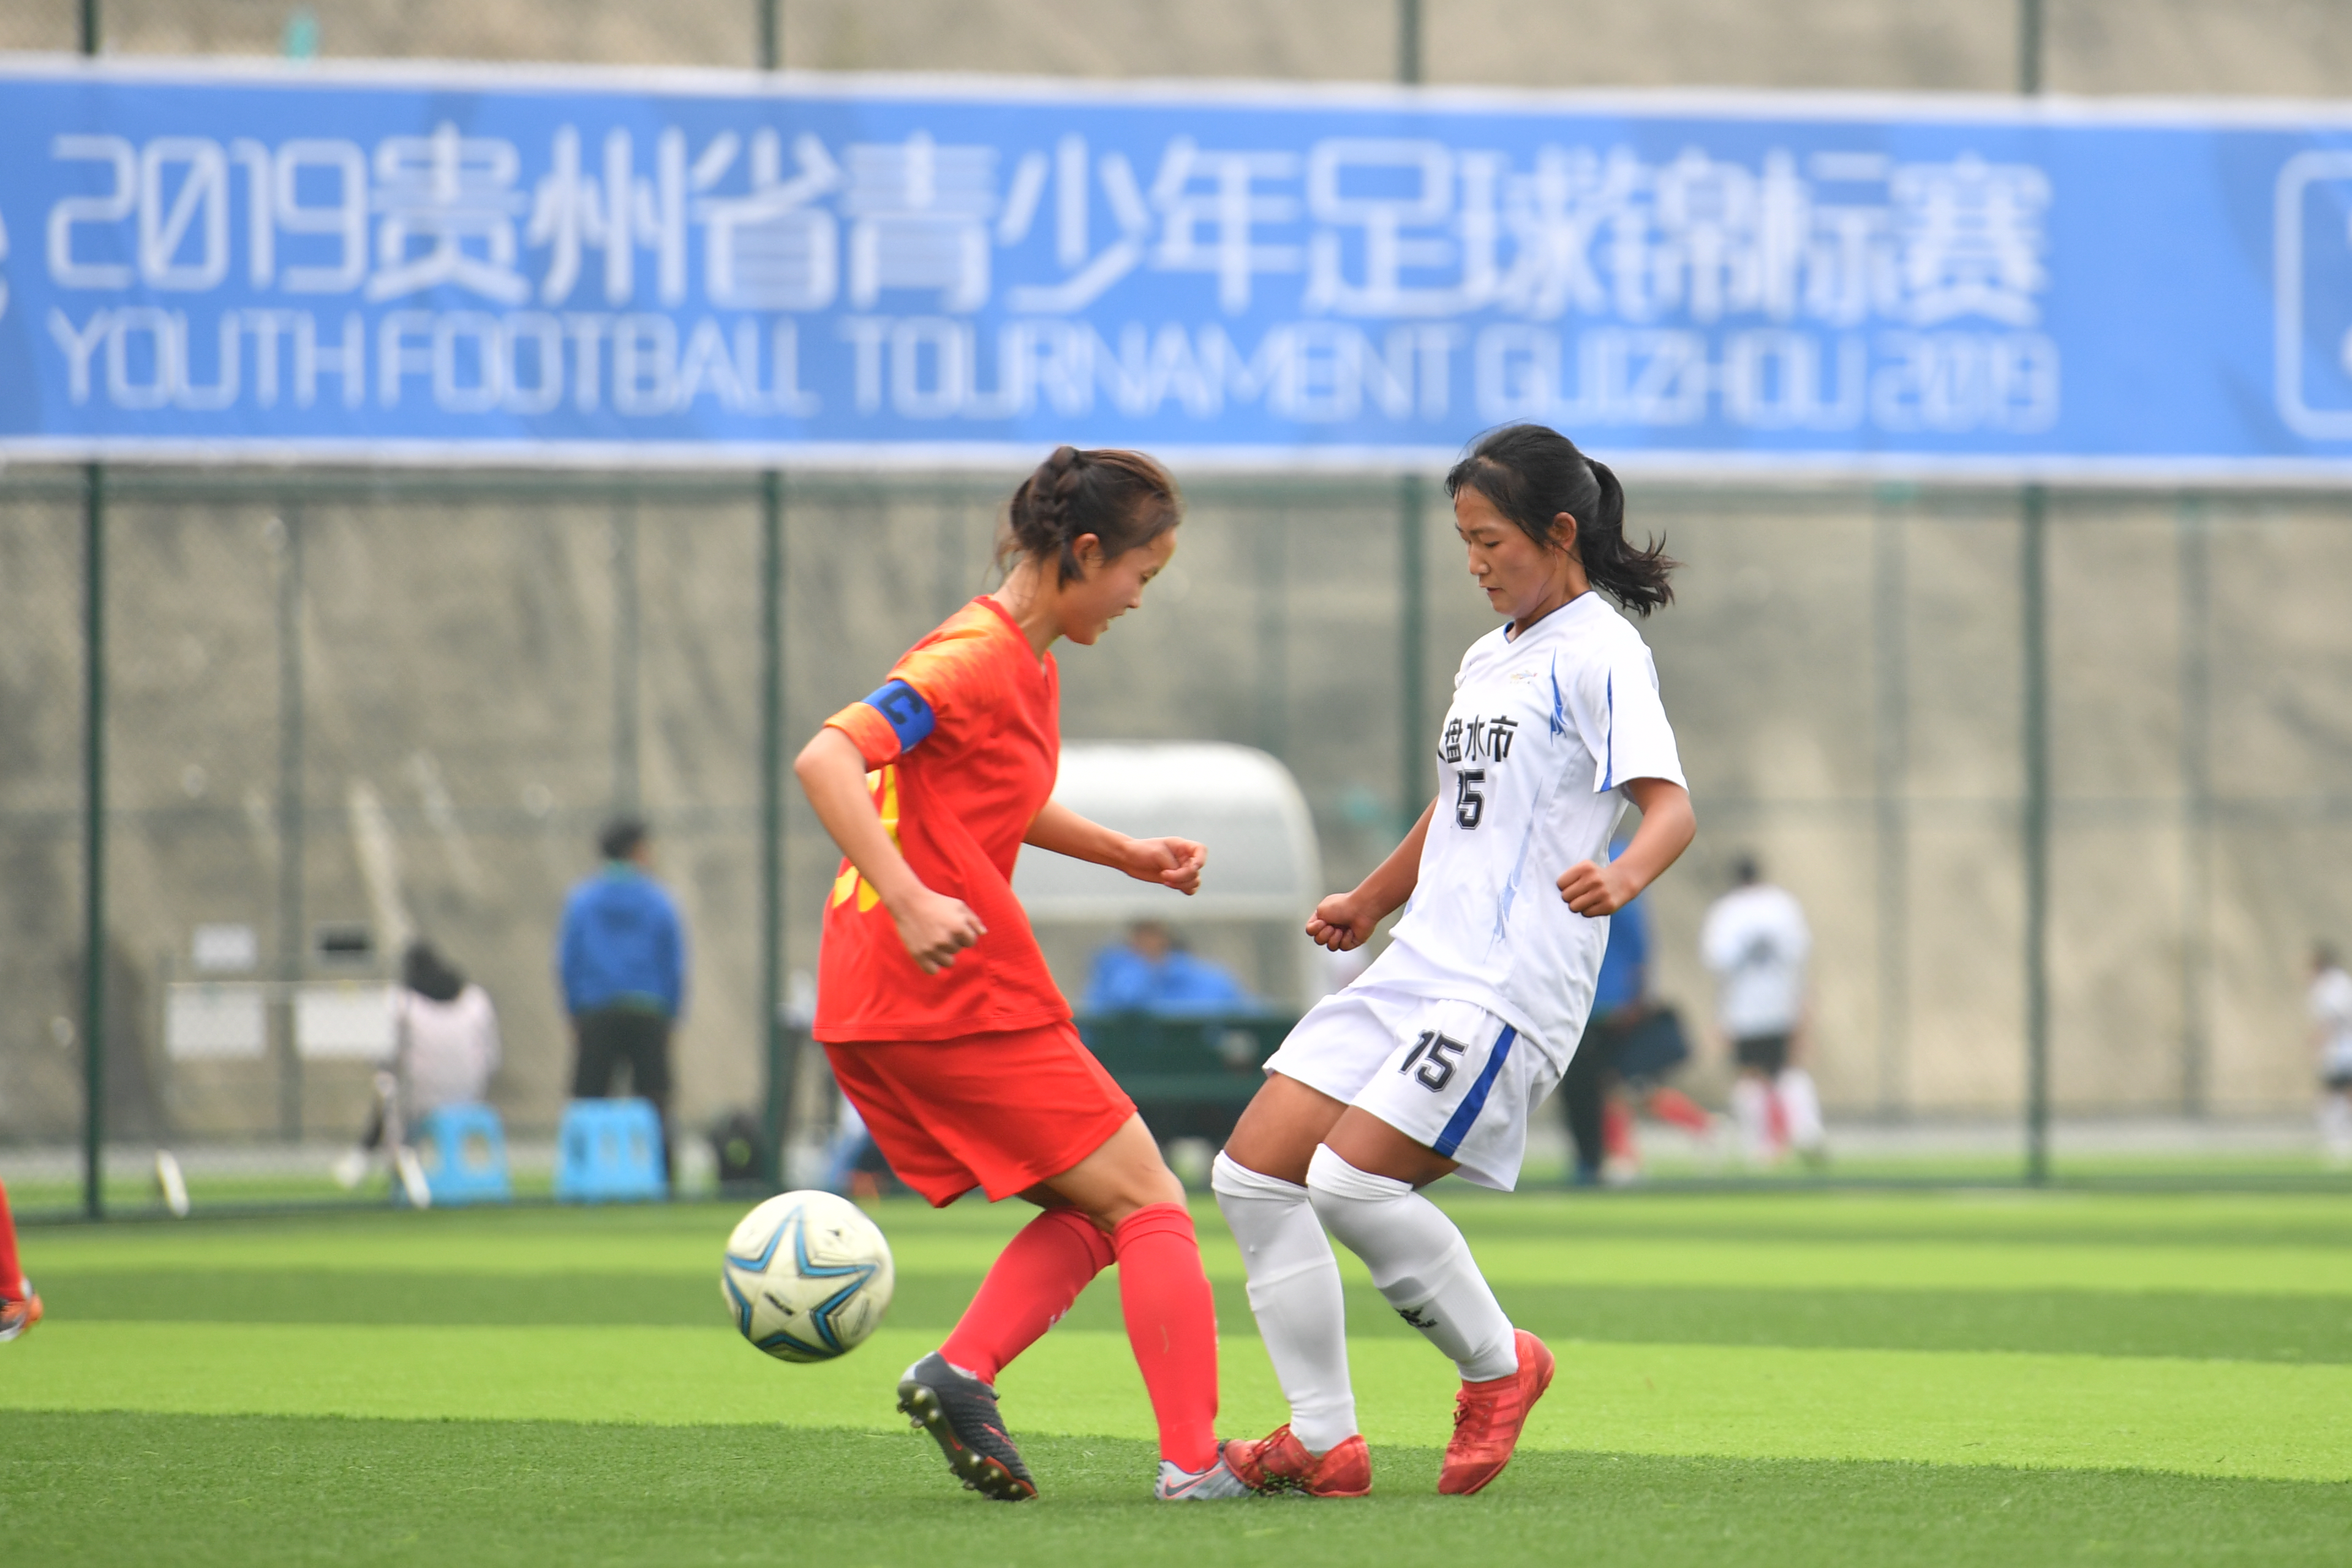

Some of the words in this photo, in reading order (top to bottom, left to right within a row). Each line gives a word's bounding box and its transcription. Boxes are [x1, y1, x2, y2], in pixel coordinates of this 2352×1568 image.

[47, 121, 2053, 327] 2019贵州省青少年足球锦标赛
[48, 307, 366, 411] YOUTH
[376, 309, 822, 418] FOOTBALL
[838, 314, 1466, 423] TOURNAMENT
[1474, 322, 1867, 431] GUIZHOU
[1871, 330, 2060, 435] 2019
[879, 687, 921, 724] C
[1438, 714, 1519, 764] 盘水市
[1456, 769, 1486, 830] 15
[1397, 1028, 1469, 1093] 15
